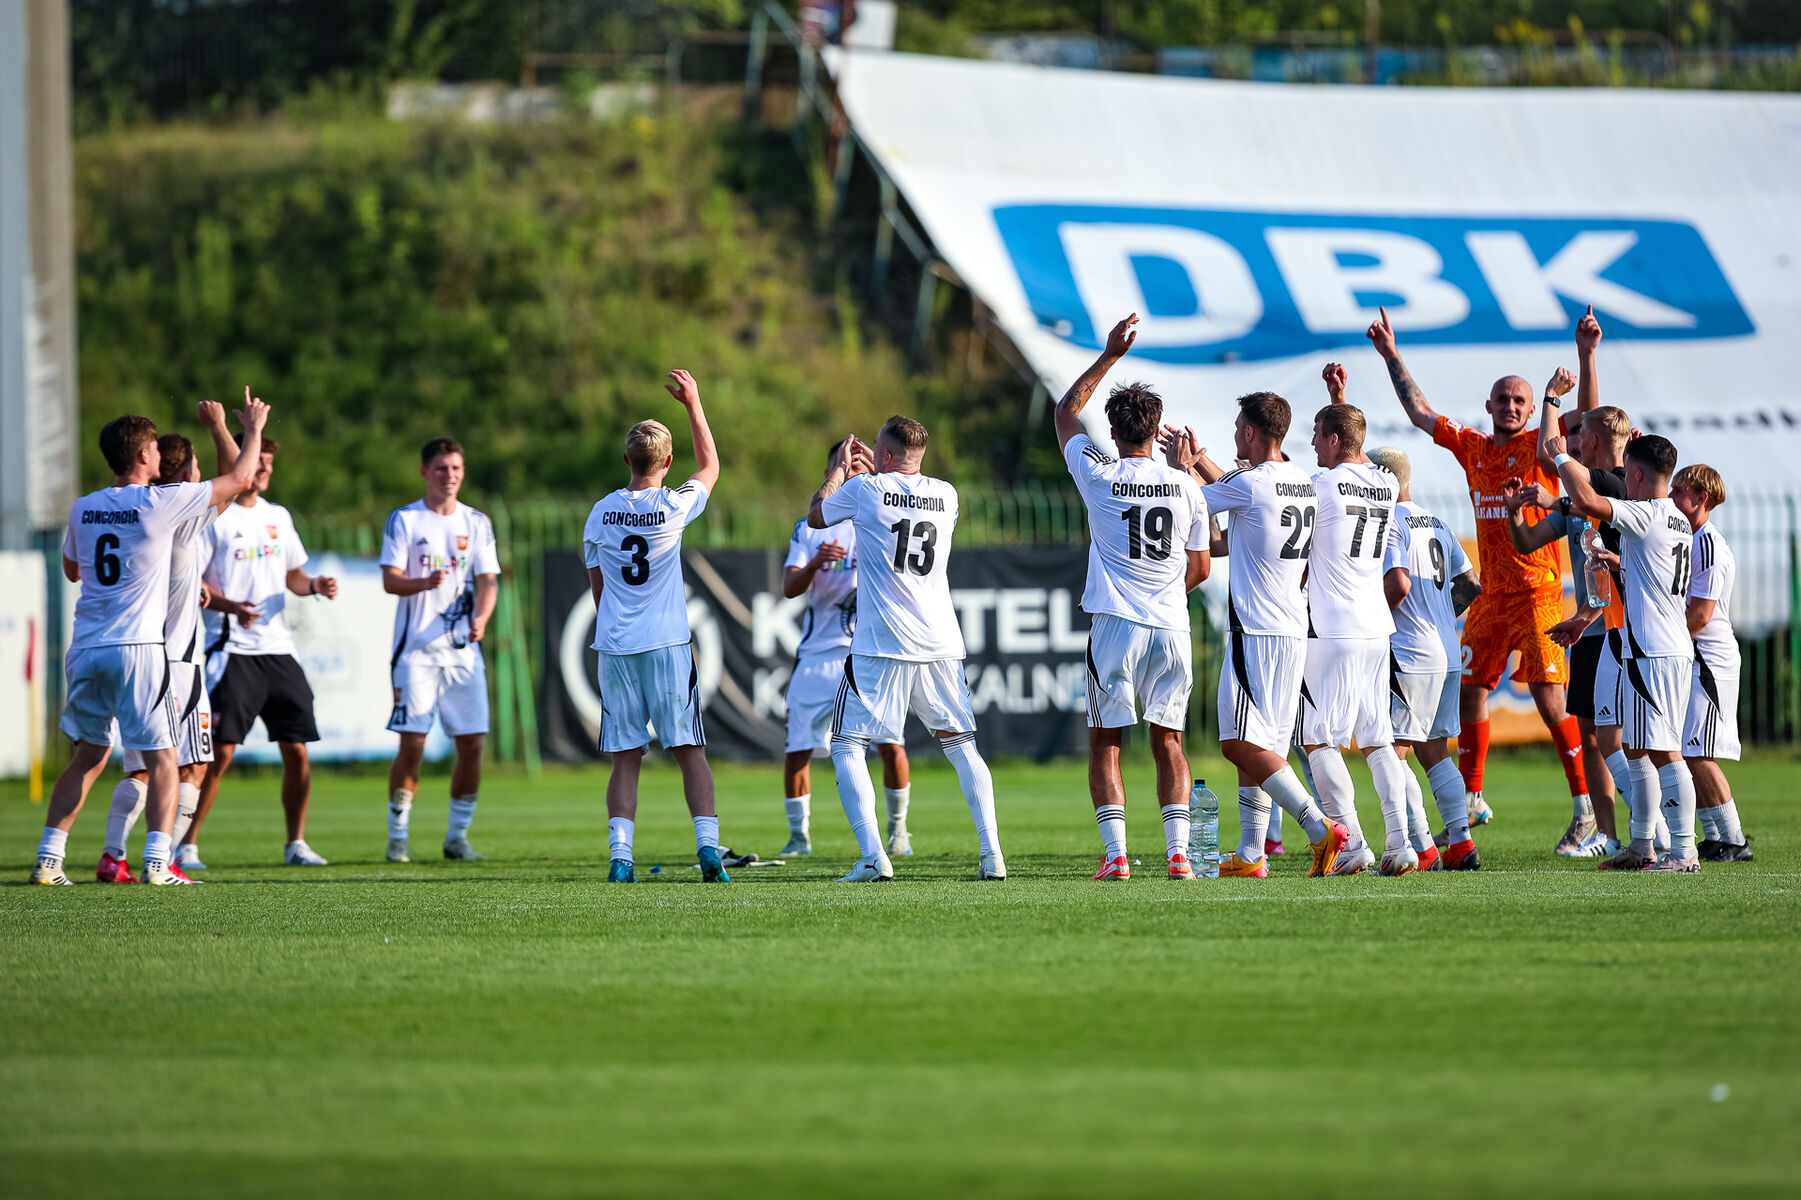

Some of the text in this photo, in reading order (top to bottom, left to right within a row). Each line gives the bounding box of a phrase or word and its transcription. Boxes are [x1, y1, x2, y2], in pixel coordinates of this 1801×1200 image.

[1059, 221, 1697, 346] DBK
[883, 491, 945, 512] CONCORDIA
[1112, 482, 1181, 498] CONCORDIA
[1338, 482, 1392, 501] CONCORDIA
[81, 509, 139, 525] CONCORDIA
[602, 510, 666, 527] CONCORDIA
[1121, 505, 1173, 561] 19
[1280, 505, 1316, 559] 22
[1346, 505, 1389, 558] 77
[94, 532, 121, 586] 6
[620, 534, 650, 586] 3
[890, 518, 937, 577] 13
[1428, 537, 1446, 592] 9
[1671, 542, 1690, 597] 11
